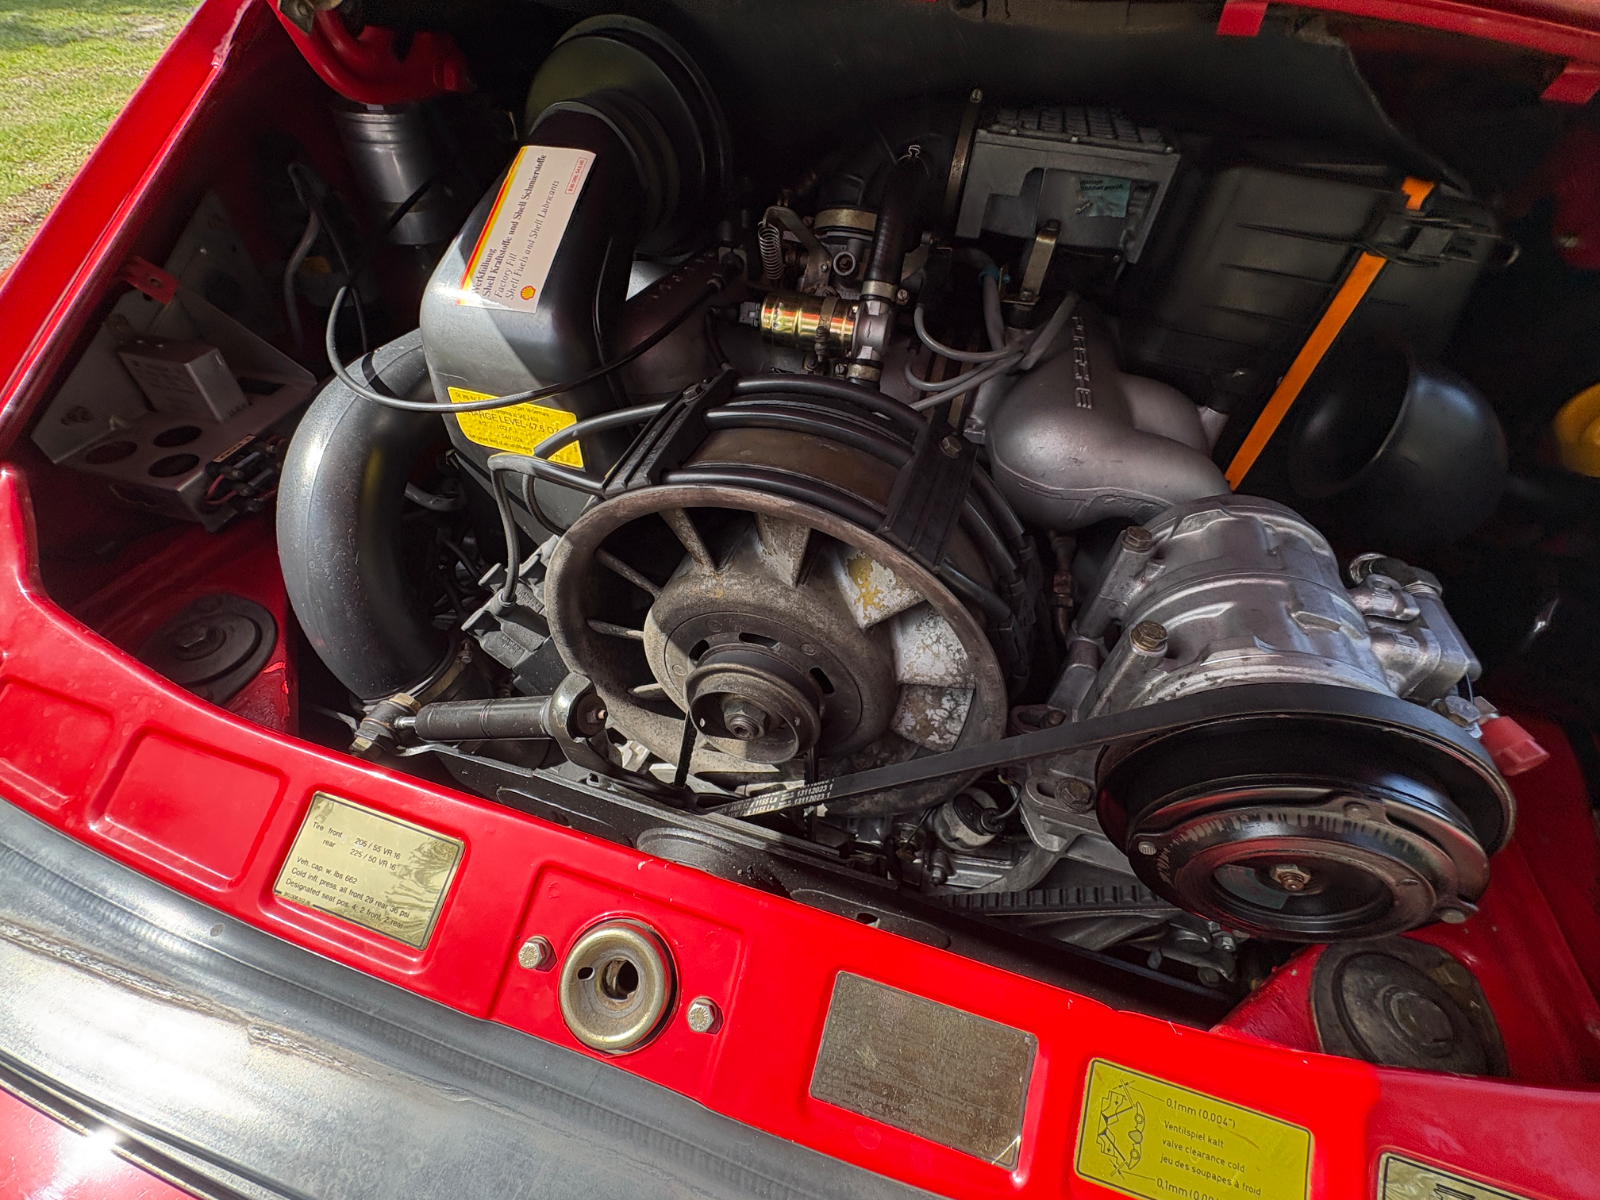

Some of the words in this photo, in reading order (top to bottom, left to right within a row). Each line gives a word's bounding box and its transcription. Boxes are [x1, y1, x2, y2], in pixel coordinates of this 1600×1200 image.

[526, 154, 547, 200] Schmierstoffe
[513, 199, 527, 220] Shell
[538, 180, 560, 218] Lubricants
[509, 221, 518, 235] und
[529, 219, 544, 239] Shell
[490, 237, 512, 274] Kraftstoffe
[526, 239, 534, 254] and
[518, 255, 528, 276] Fuels
[482, 276, 495, 297] Shell
[494, 266, 512, 298] Factory
[505, 277, 519, 300] Shell
[498, 413, 526, 428] LEVEL
[794, 794, 825, 805] 13112023
[797, 786, 828, 797] 13112023
[313, 821, 324, 832] Tire
[328, 827, 343, 838] front
[354, 837, 368, 848] 205
[372, 843, 382, 852] 55
[382, 847, 393, 857] VR
[394, 851, 401, 860] 16
[322, 839, 337, 848] rear
[350, 848, 363, 859] 225
[367, 854, 377, 864] 50
[378, 858, 388, 868] VR
[389, 862, 396, 871] 16
[297, 856, 310, 867] Veh.
[334, 870, 343, 880] lbs
[344, 874, 358, 885] 662
[286, 878, 320, 896] Designated
[321, 890, 335, 902] seat
[390, 918, 404, 929] rear
[291, 867, 306, 878] Cold
[319, 877, 338, 890] press.
[339, 884, 347, 894] all
[348, 888, 364, 900] front
[365, 894, 374, 904] 29
[375, 900, 388, 909] rear
[389, 905, 398, 914] 36
[400, 910, 410, 918] psi
[1164, 1120, 1206, 1141] Ventilspiel
[1207, 1134, 1225, 1148] kalt
[1162, 1137, 1183, 1152] valve
[1185, 1145, 1226, 1166] clearance
[1227, 1158, 1246, 1173] cold
[1160, 1153, 1173, 1166] jeu
[1174, 1159, 1190, 1171] des
[1191, 1166, 1232, 1187] soupapes
[1234, 1179, 1240, 1189] à
[1242, 1182, 1262, 1197] froid
